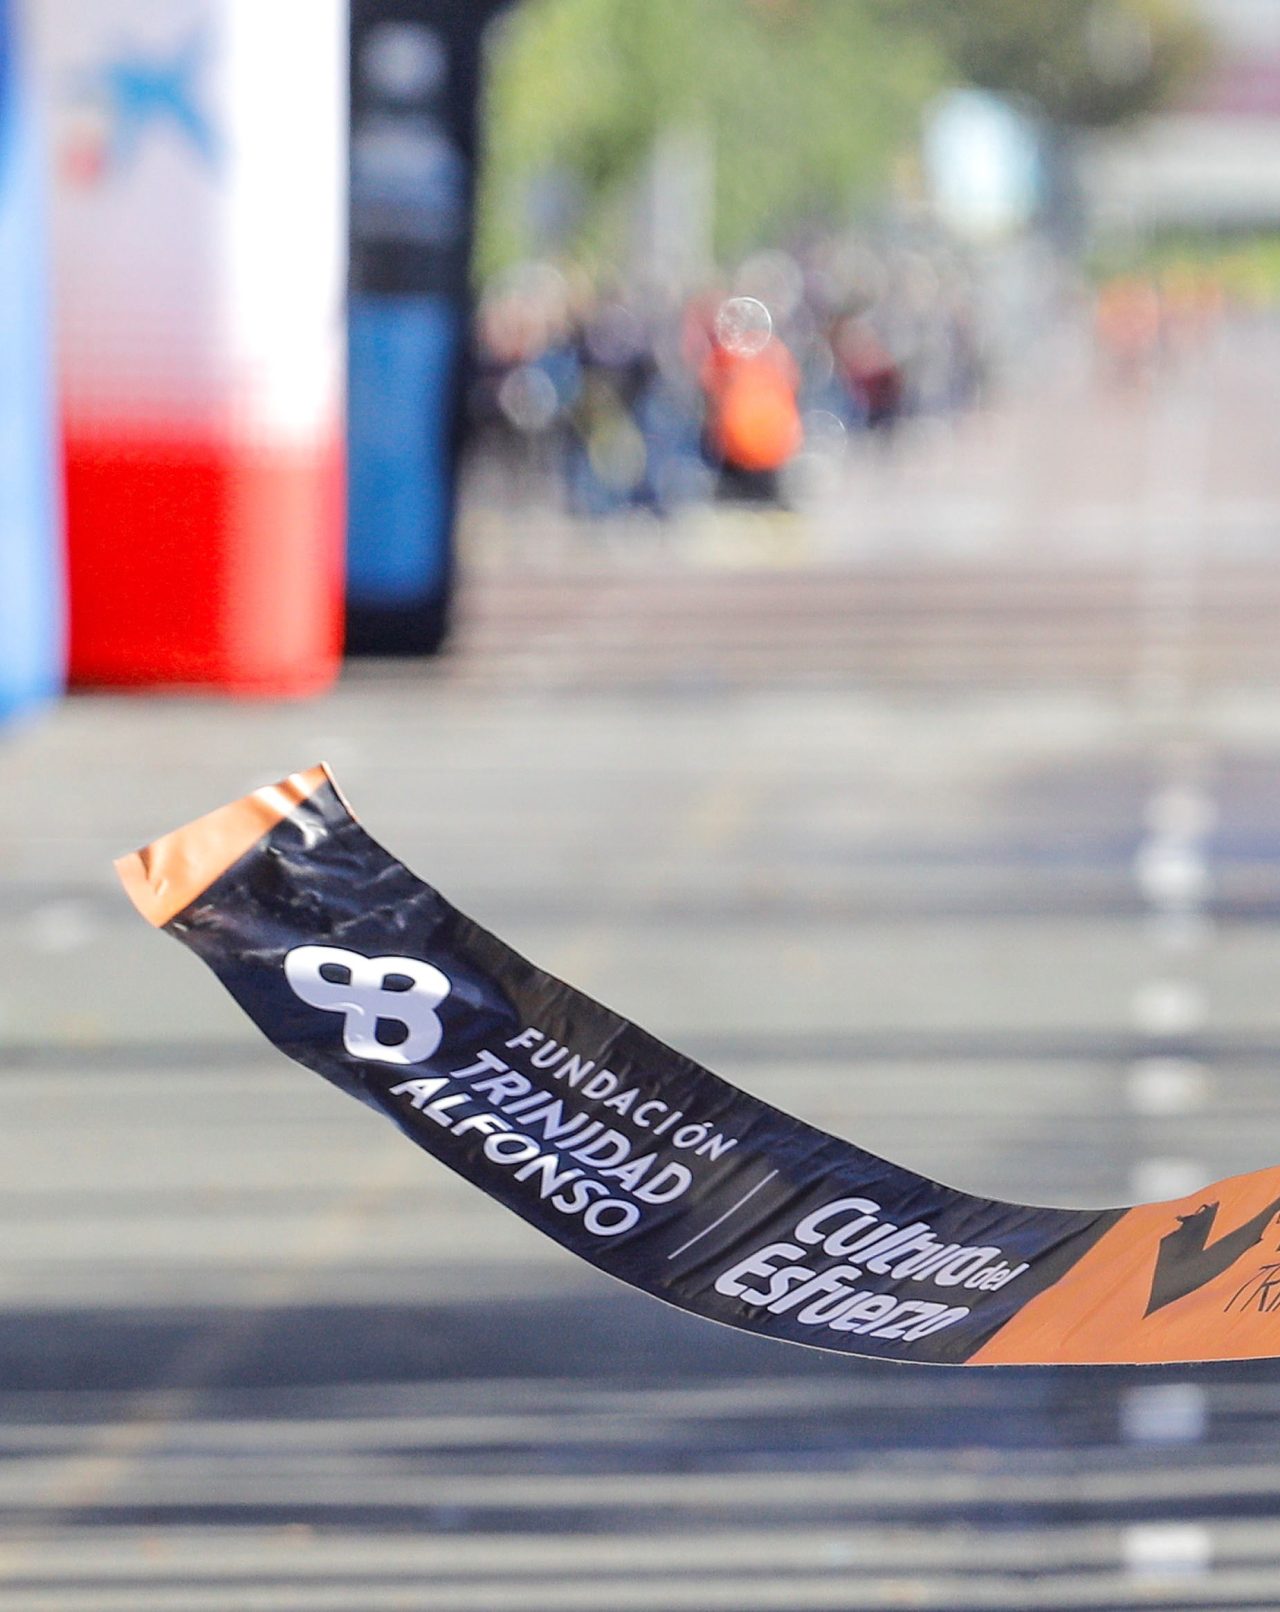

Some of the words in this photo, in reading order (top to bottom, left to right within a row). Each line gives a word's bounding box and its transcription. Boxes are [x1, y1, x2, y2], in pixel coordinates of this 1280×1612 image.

[389, 1077, 641, 1236] ALFONSO
[449, 1048, 694, 1205] TRINIDAD
[505, 1027, 738, 1162] FUNDACIÓN
[714, 1242, 971, 1342] Esfuerzo
[963, 1260, 1030, 1292] del
